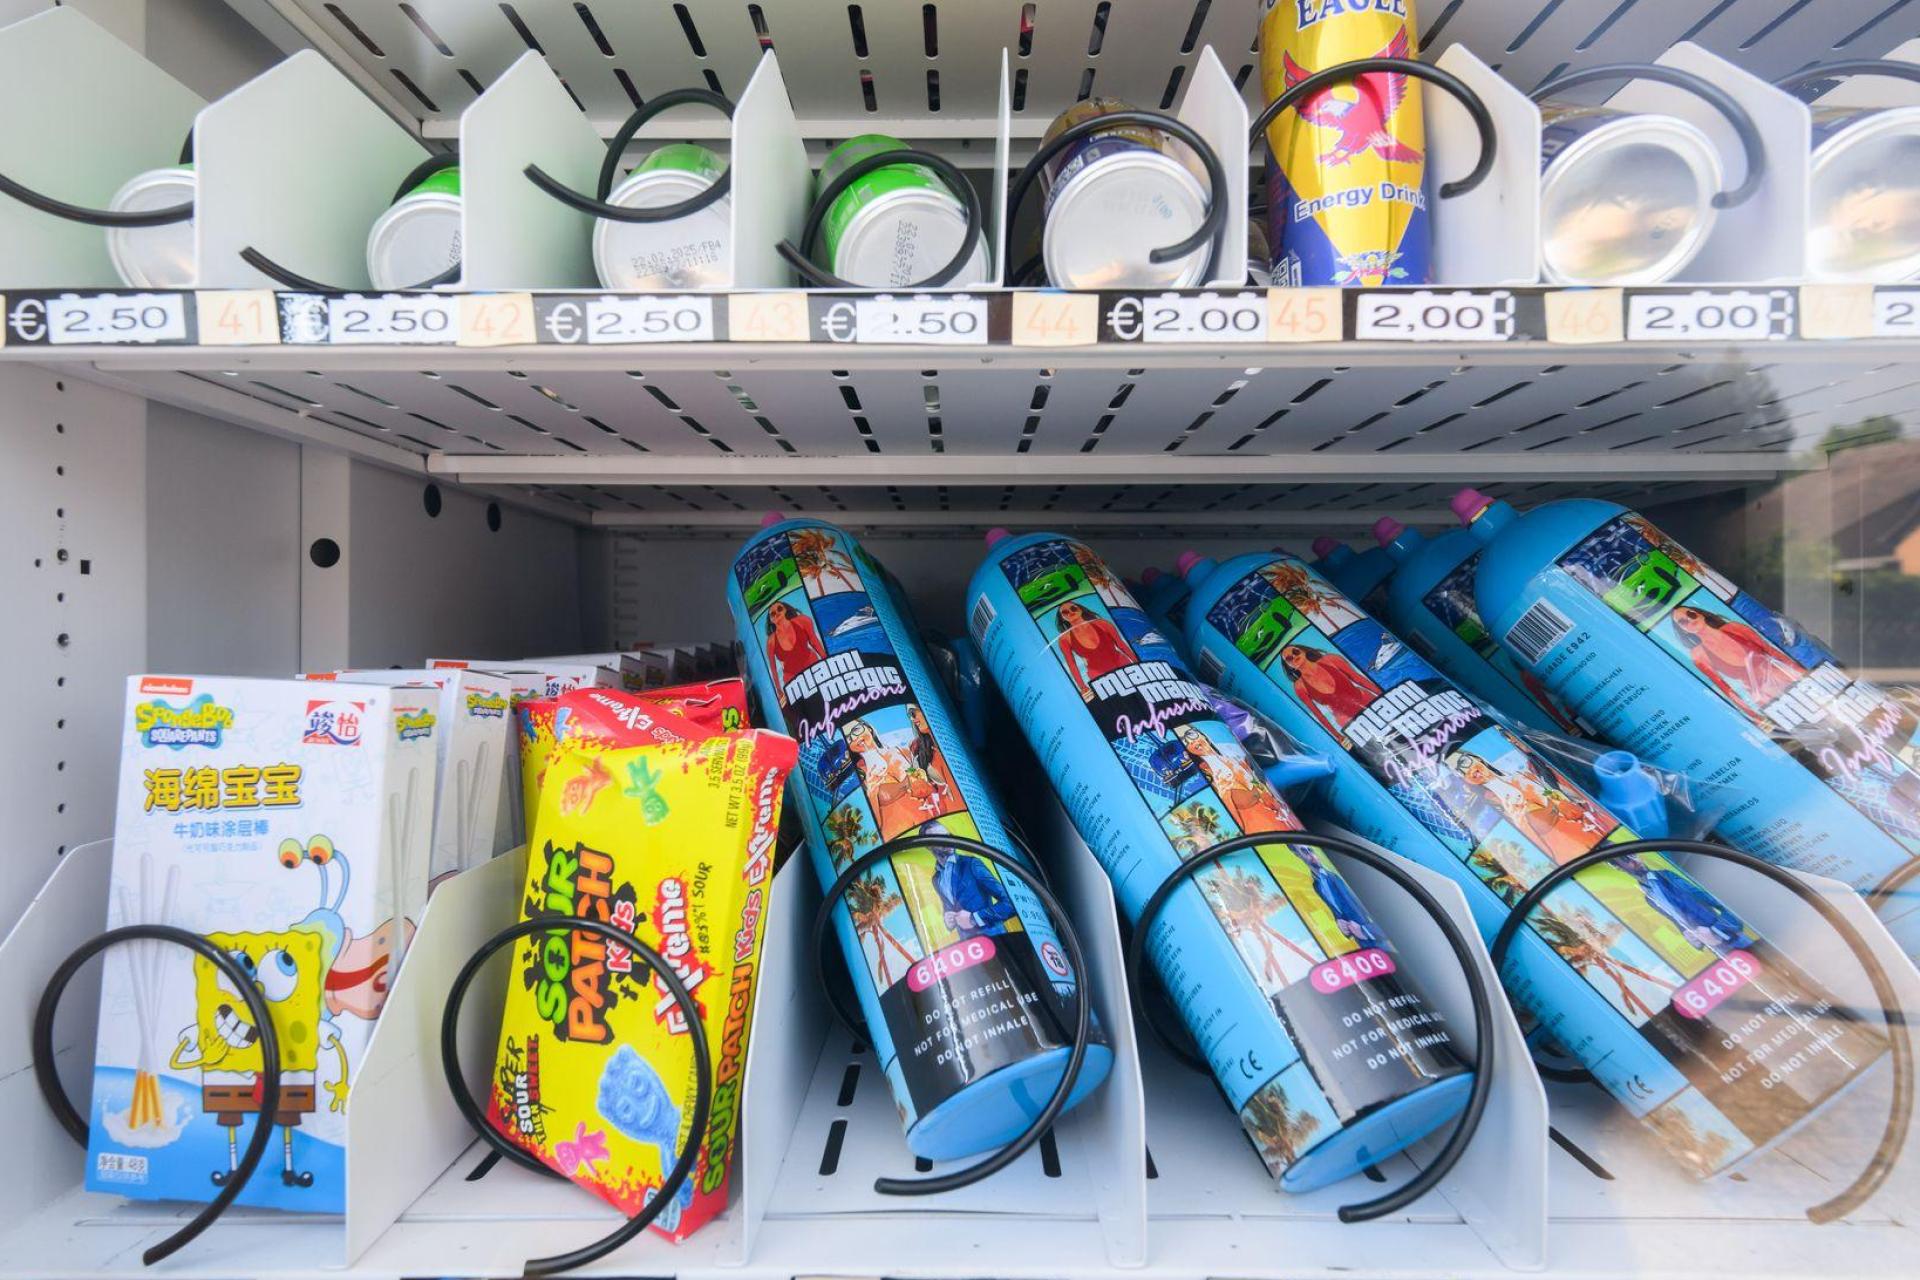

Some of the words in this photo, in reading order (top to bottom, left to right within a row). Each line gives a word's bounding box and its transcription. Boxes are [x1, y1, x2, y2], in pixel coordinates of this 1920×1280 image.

[1294, 188, 1374, 223] Energy
[8, 298, 47, 341] €
[64, 306, 169, 333] 2.50
[218, 298, 263, 336] 41
[343, 308, 449, 333] 2.50
[471, 301, 523, 339] 42
[545, 302, 582, 343] €
[596, 308, 701, 335] 2.50
[744, 301, 795, 337] 43
[821, 302, 857, 342] €
[1026, 302, 1079, 338] 44
[1106, 297, 1143, 340] €
[1153, 308, 1260, 332] 2.00
[1276, 297, 1326, 334] 45
[1372, 305, 1484, 332] 2,00
[1561, 299, 1612, 335] 46
[1645, 305, 1758, 332] 2,00
[797, 683, 907, 749] Infusions
[143, 762, 304, 815] 海绵宝宝
[731, 778, 744, 793] 3.5
[733, 763, 746, 777] OZ
[725, 811, 738, 828] NET
[728, 794, 742, 810] WT
[692, 862, 713, 899] SOUR
[537, 849, 579, 1024] SOUR
[568, 849, 614, 1042] PATCH
[916, 941, 985, 985] 640G
[1320, 951, 1389, 988] 640G
[925, 1009, 941, 1025] DO
[944, 996, 968, 1017] NOT
[971, 980, 1011, 1003] REFILL
[1684, 955, 1753, 1014] 640G
[716, 962, 755, 1084] PATCH
[914, 1038, 934, 1056] NOT
[936, 1025, 961, 1044] FOR
[960, 1000, 1015, 1026] MEDICAL
[1017, 992, 1039, 1006] USE
[1342, 1011, 1362, 1028] DO
[1365, 1001, 1388, 1018] NOT
[1389, 993, 1421, 1010] REFILL
[937, 1051, 953, 1066] DO
[955, 1036, 980, 1055] NOT
[984, 1015, 1031, 1041] INHALE
[1331, 1040, 1359, 1060] NOT
[1362, 1027, 1388, 1046] FOR
[1389, 1013, 1430, 1034] MEDICAL
[1721, 1034, 1744, 1051] DO
[1739, 1012, 1769, 1037] NOT
[1366, 1053, 1386, 1071] DO
[1390, 1042, 1414, 1060] NOT
[1720, 1064, 1746, 1086] NOT
[1746, 1045, 1772, 1068] FOR
[1761, 1070, 1781, 1089] DO
[1780, 1050, 1809, 1075] NOT
[516, 1074, 535, 1134] SOUR
[529, 1103, 547, 1145] THEN
[702, 1077, 739, 1195] SOUR
